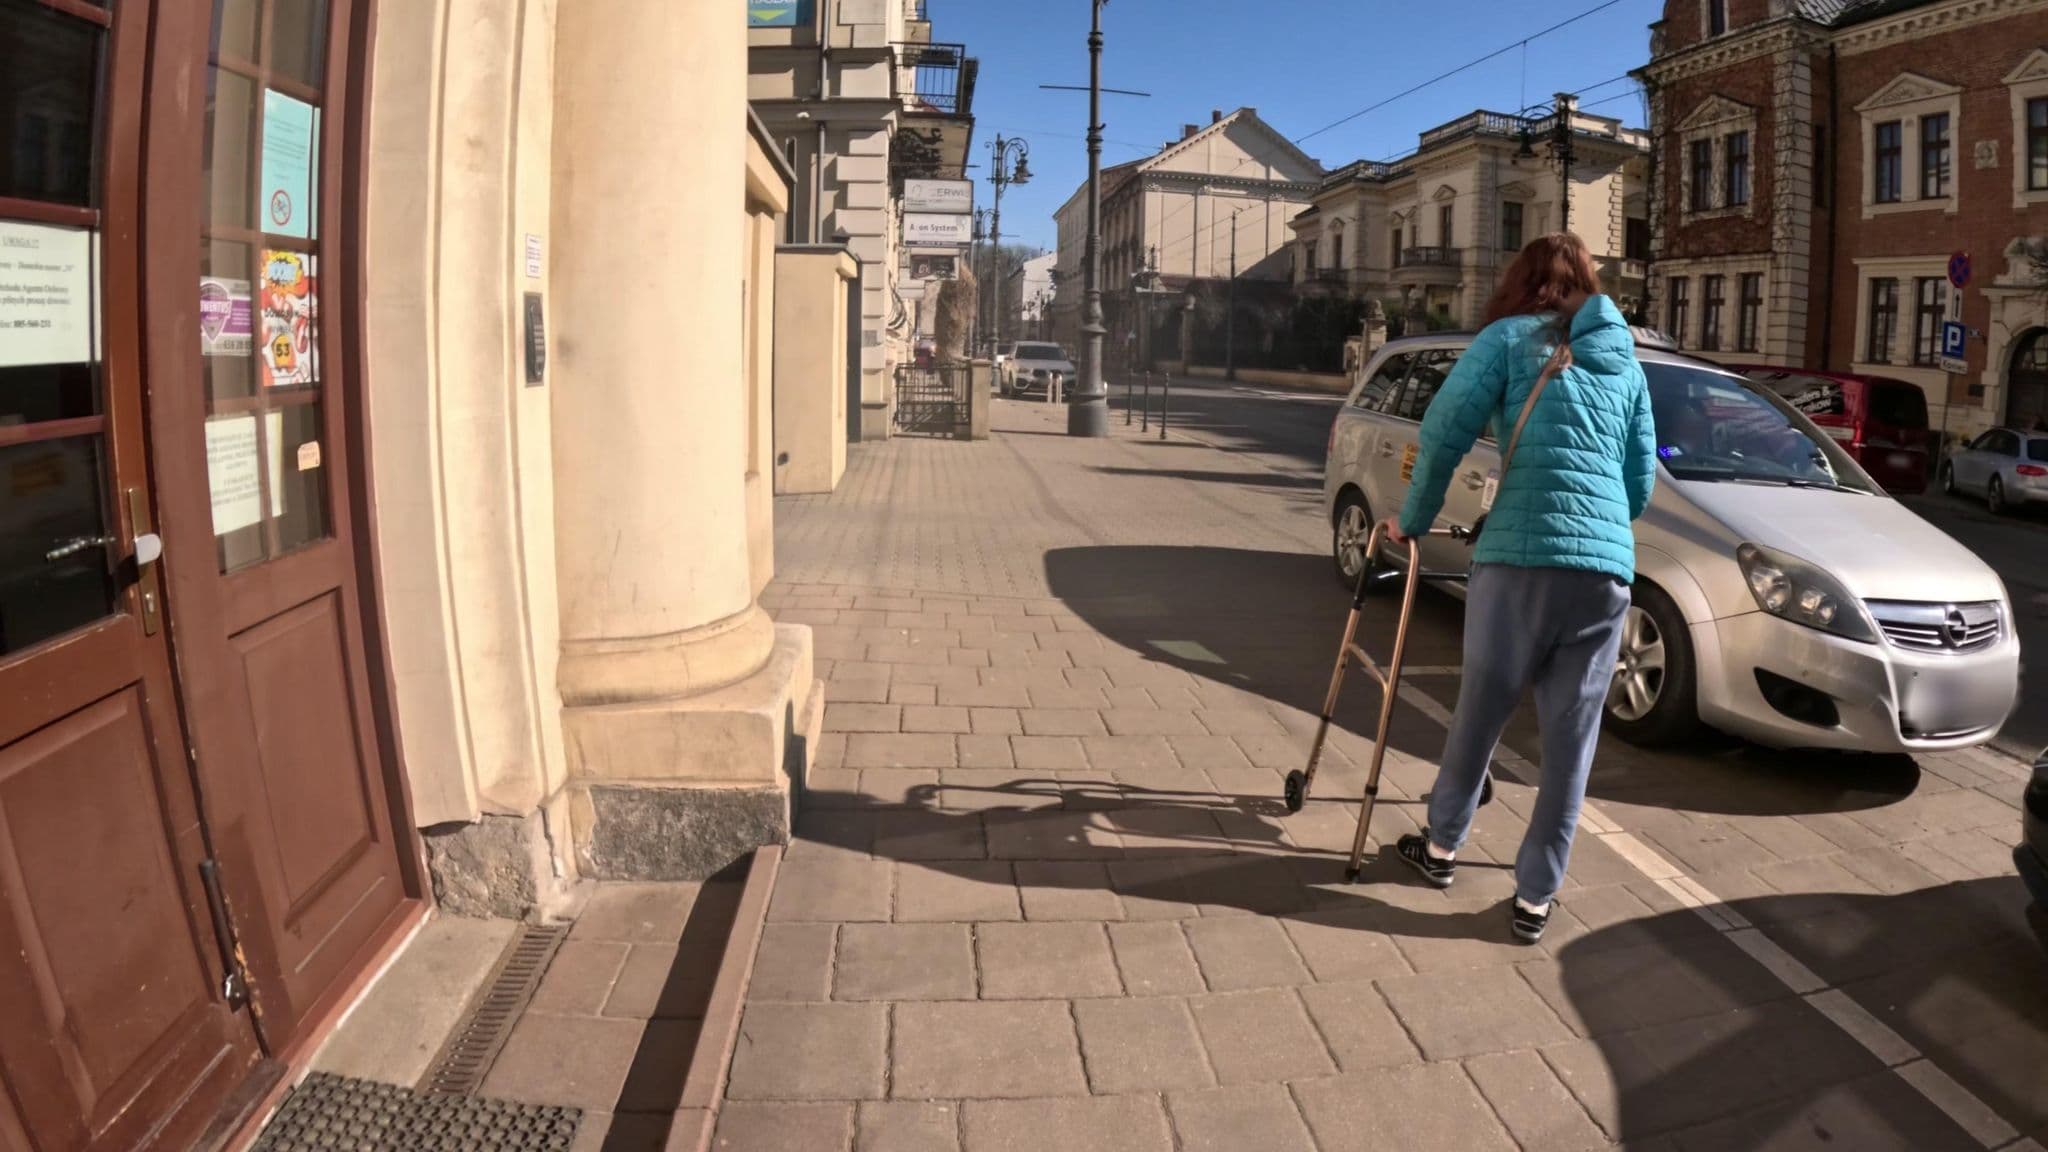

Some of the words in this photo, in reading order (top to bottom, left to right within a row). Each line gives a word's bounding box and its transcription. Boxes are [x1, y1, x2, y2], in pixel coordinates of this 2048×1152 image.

[930, 223, 958, 232] System
[1946, 325, 1961, 353] P
[275, 343, 291, 357] 53
